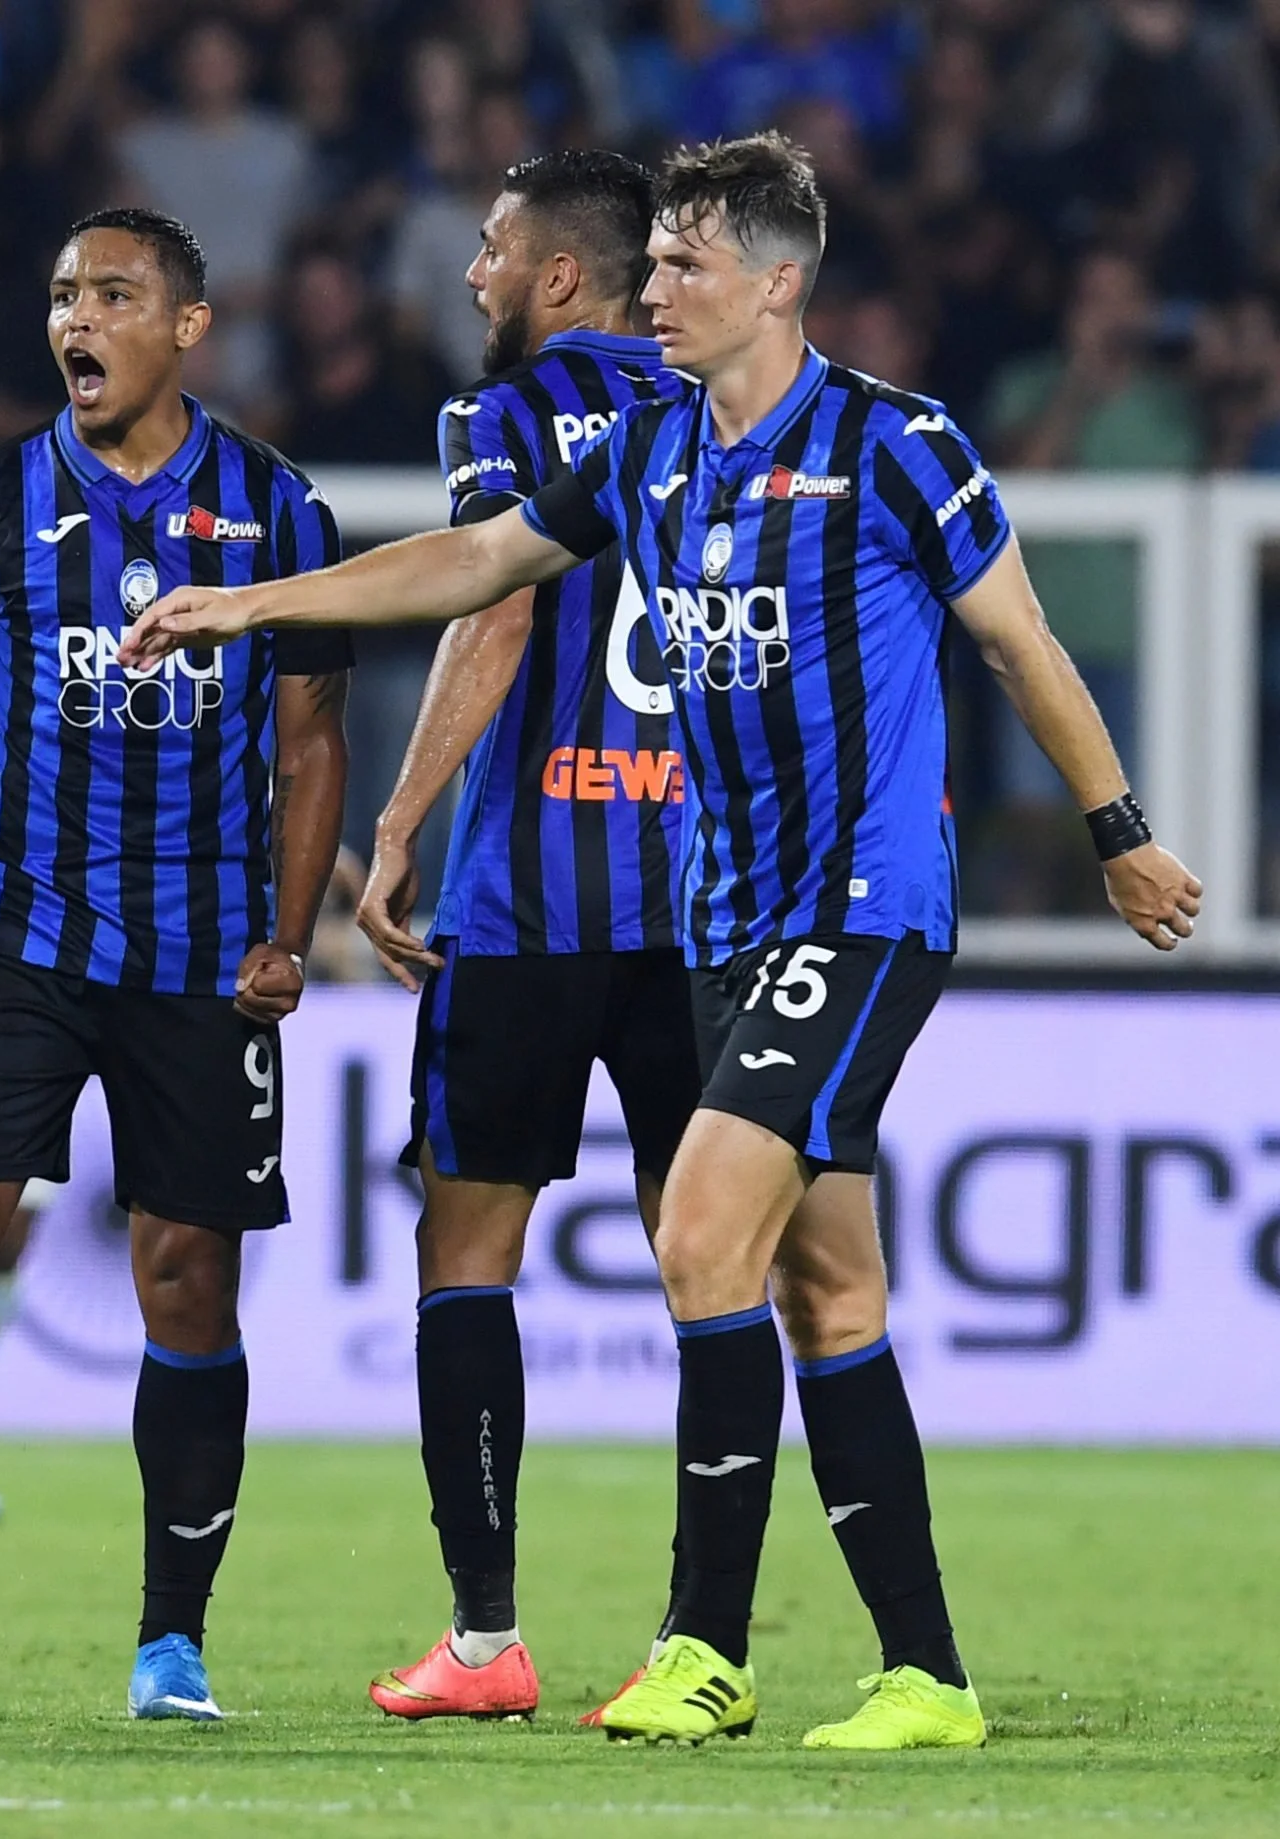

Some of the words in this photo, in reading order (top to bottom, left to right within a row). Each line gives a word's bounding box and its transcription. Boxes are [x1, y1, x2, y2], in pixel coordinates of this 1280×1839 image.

[787, 472, 850, 498] Power
[935, 464, 998, 528] AUTO
[212, 517, 266, 540] Powe
[656, 586, 790, 641] RADICI
[662, 641, 790, 692] GROUP
[58, 679, 224, 730] GROUP
[743, 944, 837, 1019] 15
[244, 1034, 273, 1119] 9
